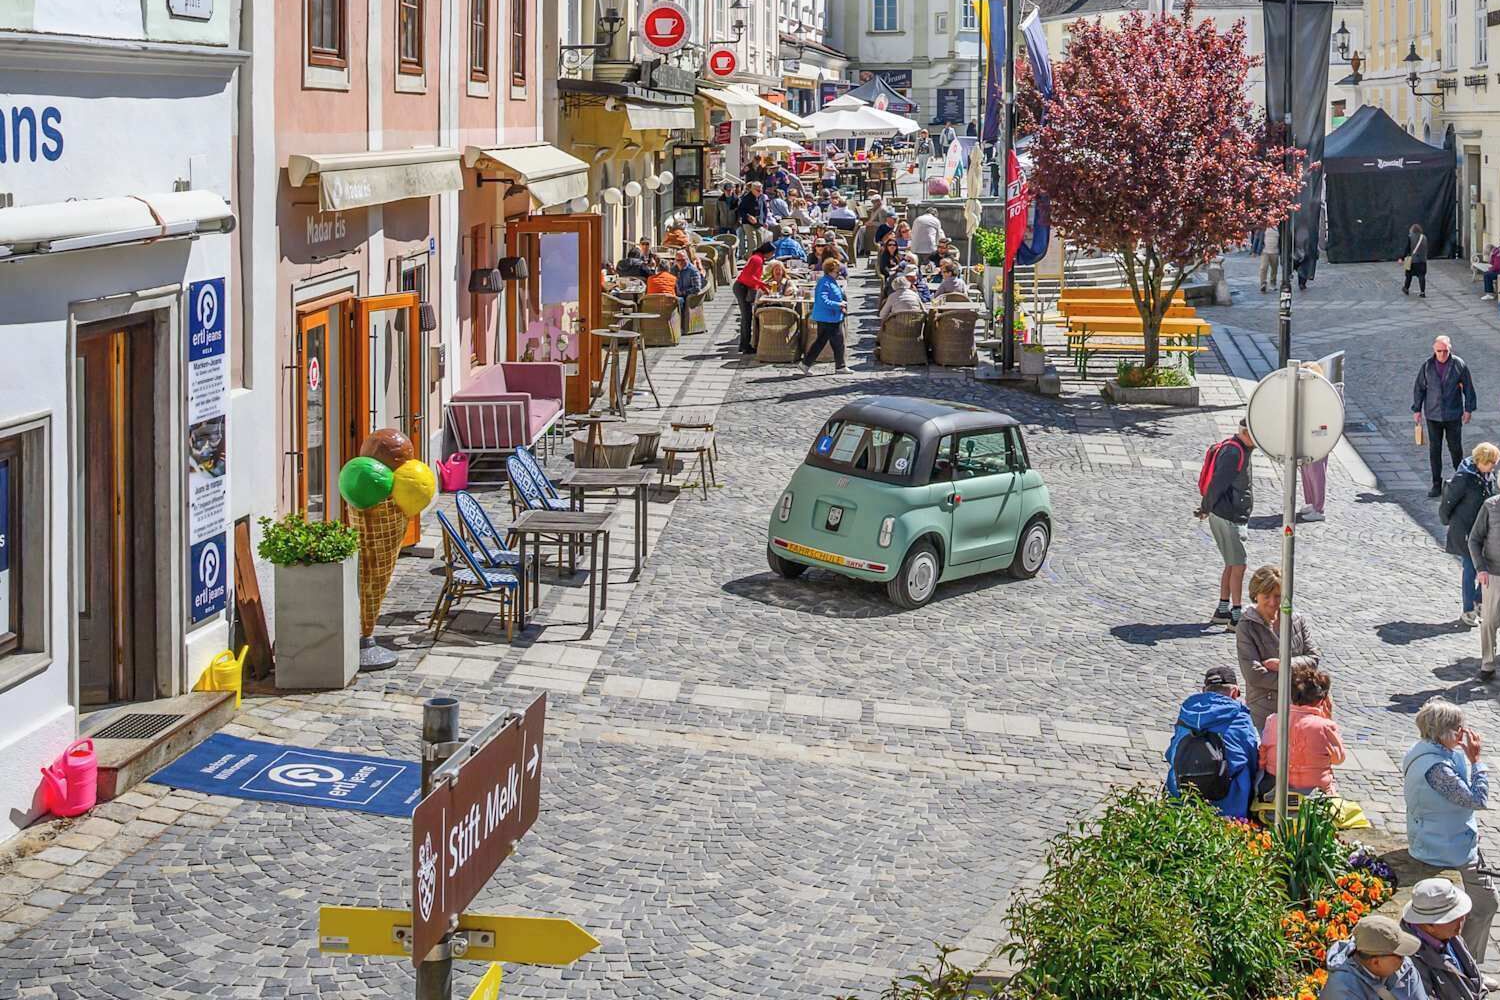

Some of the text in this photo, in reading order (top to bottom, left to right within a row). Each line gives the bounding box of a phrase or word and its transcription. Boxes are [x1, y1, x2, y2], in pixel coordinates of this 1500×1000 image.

[306, 213, 346, 245] Madar Eis
[192, 328, 222, 346] ertl jeans
[820, 439, 827, 450] L
[787, 543, 845, 565] FAHRSCHULE
[195, 585, 224, 608] ertl jeans
[328, 765, 377, 797] ertl jeans
[449, 764, 520, 878] Stift Melk
